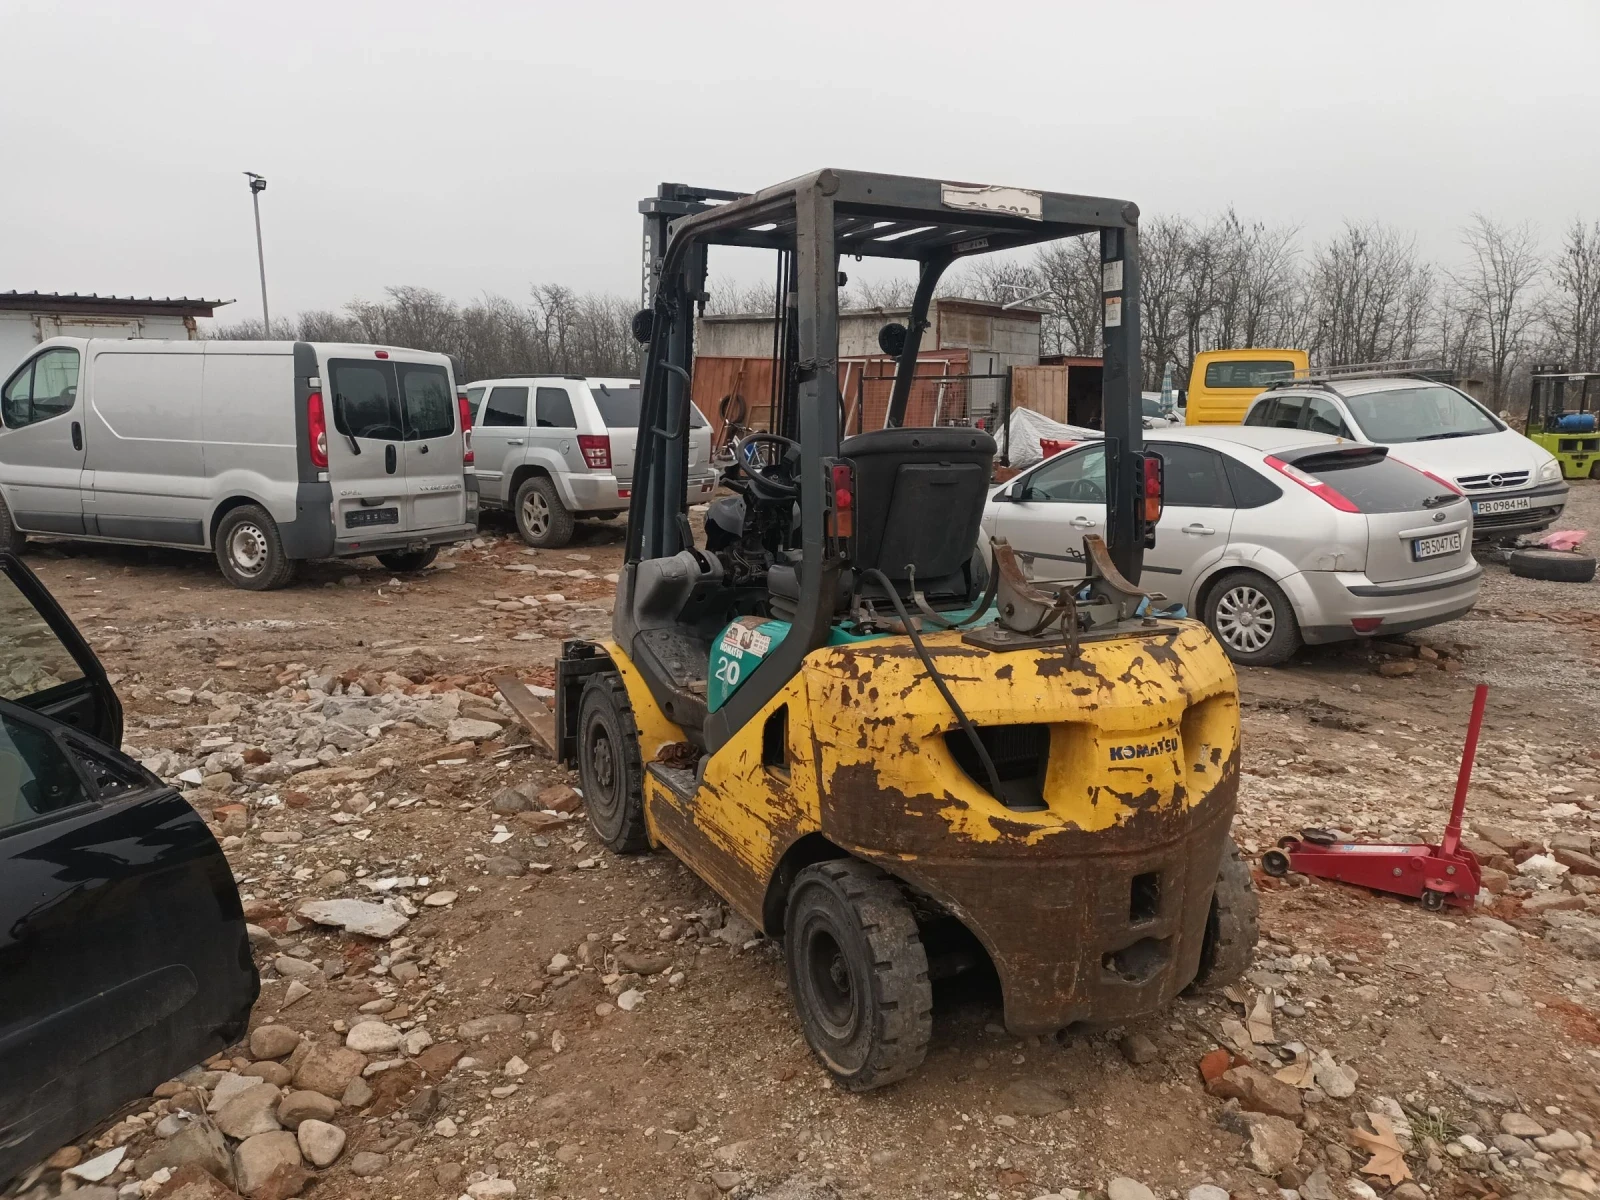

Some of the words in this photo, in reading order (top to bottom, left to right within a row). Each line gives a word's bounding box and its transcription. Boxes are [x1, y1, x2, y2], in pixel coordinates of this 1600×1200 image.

[643, 235, 652, 310] MATSU
[1479, 503, 1491, 513] PB
[1493, 500, 1515, 511] 0984
[1517, 499, 1529, 508] HA
[1421, 542, 1431, 555] PB
[1431, 537, 1448, 553] 5047
[1449, 536, 1459, 549] KE
[719, 641, 744, 660] KOMATSU
[715, 656, 740, 685] 20
[1109, 738, 1178, 761] KOMATSU
